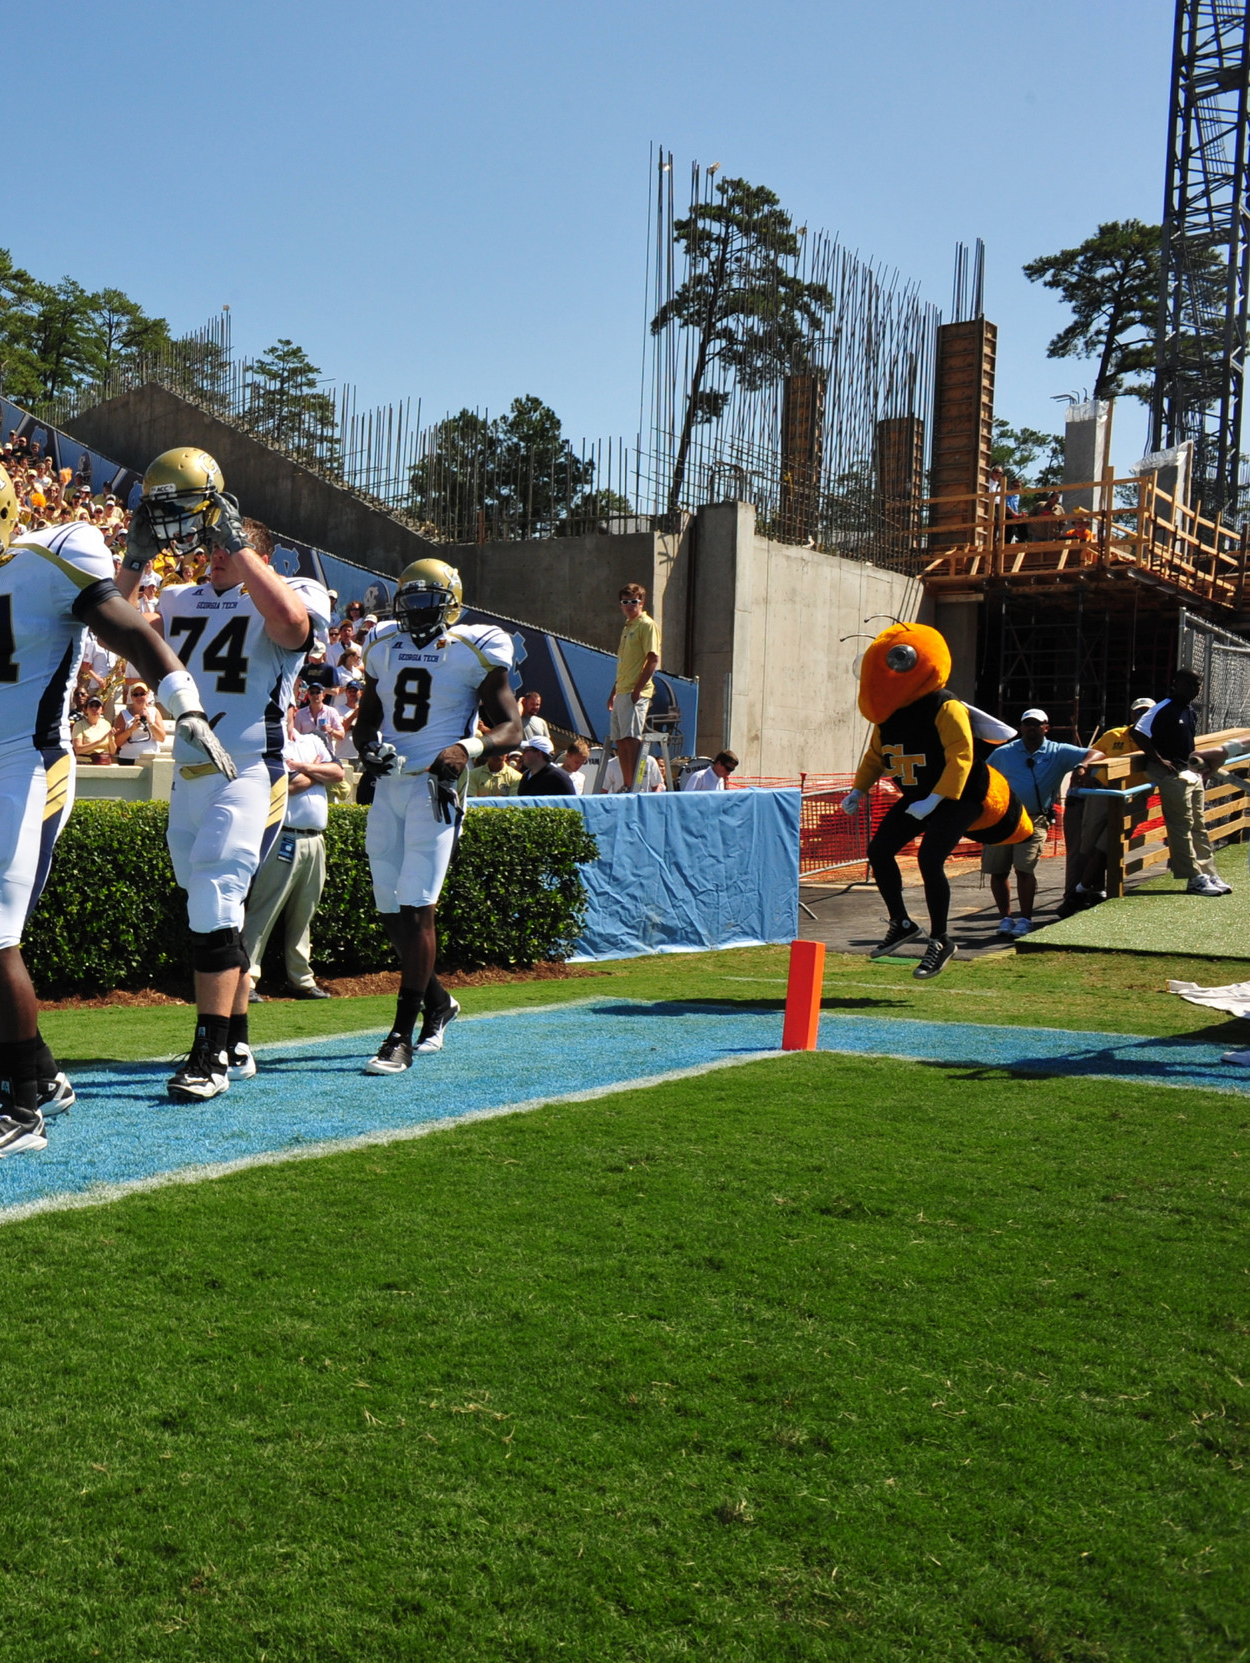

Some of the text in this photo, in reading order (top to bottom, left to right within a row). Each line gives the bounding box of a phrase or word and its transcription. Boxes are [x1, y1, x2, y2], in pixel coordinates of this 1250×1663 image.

[196, 602, 220, 610] GEORGIA
[169, 616, 251, 694] 74
[398, 653, 439, 662] GEORGIA TECH
[393, 667, 432, 732] 8
[882, 744, 926, 785] GT
